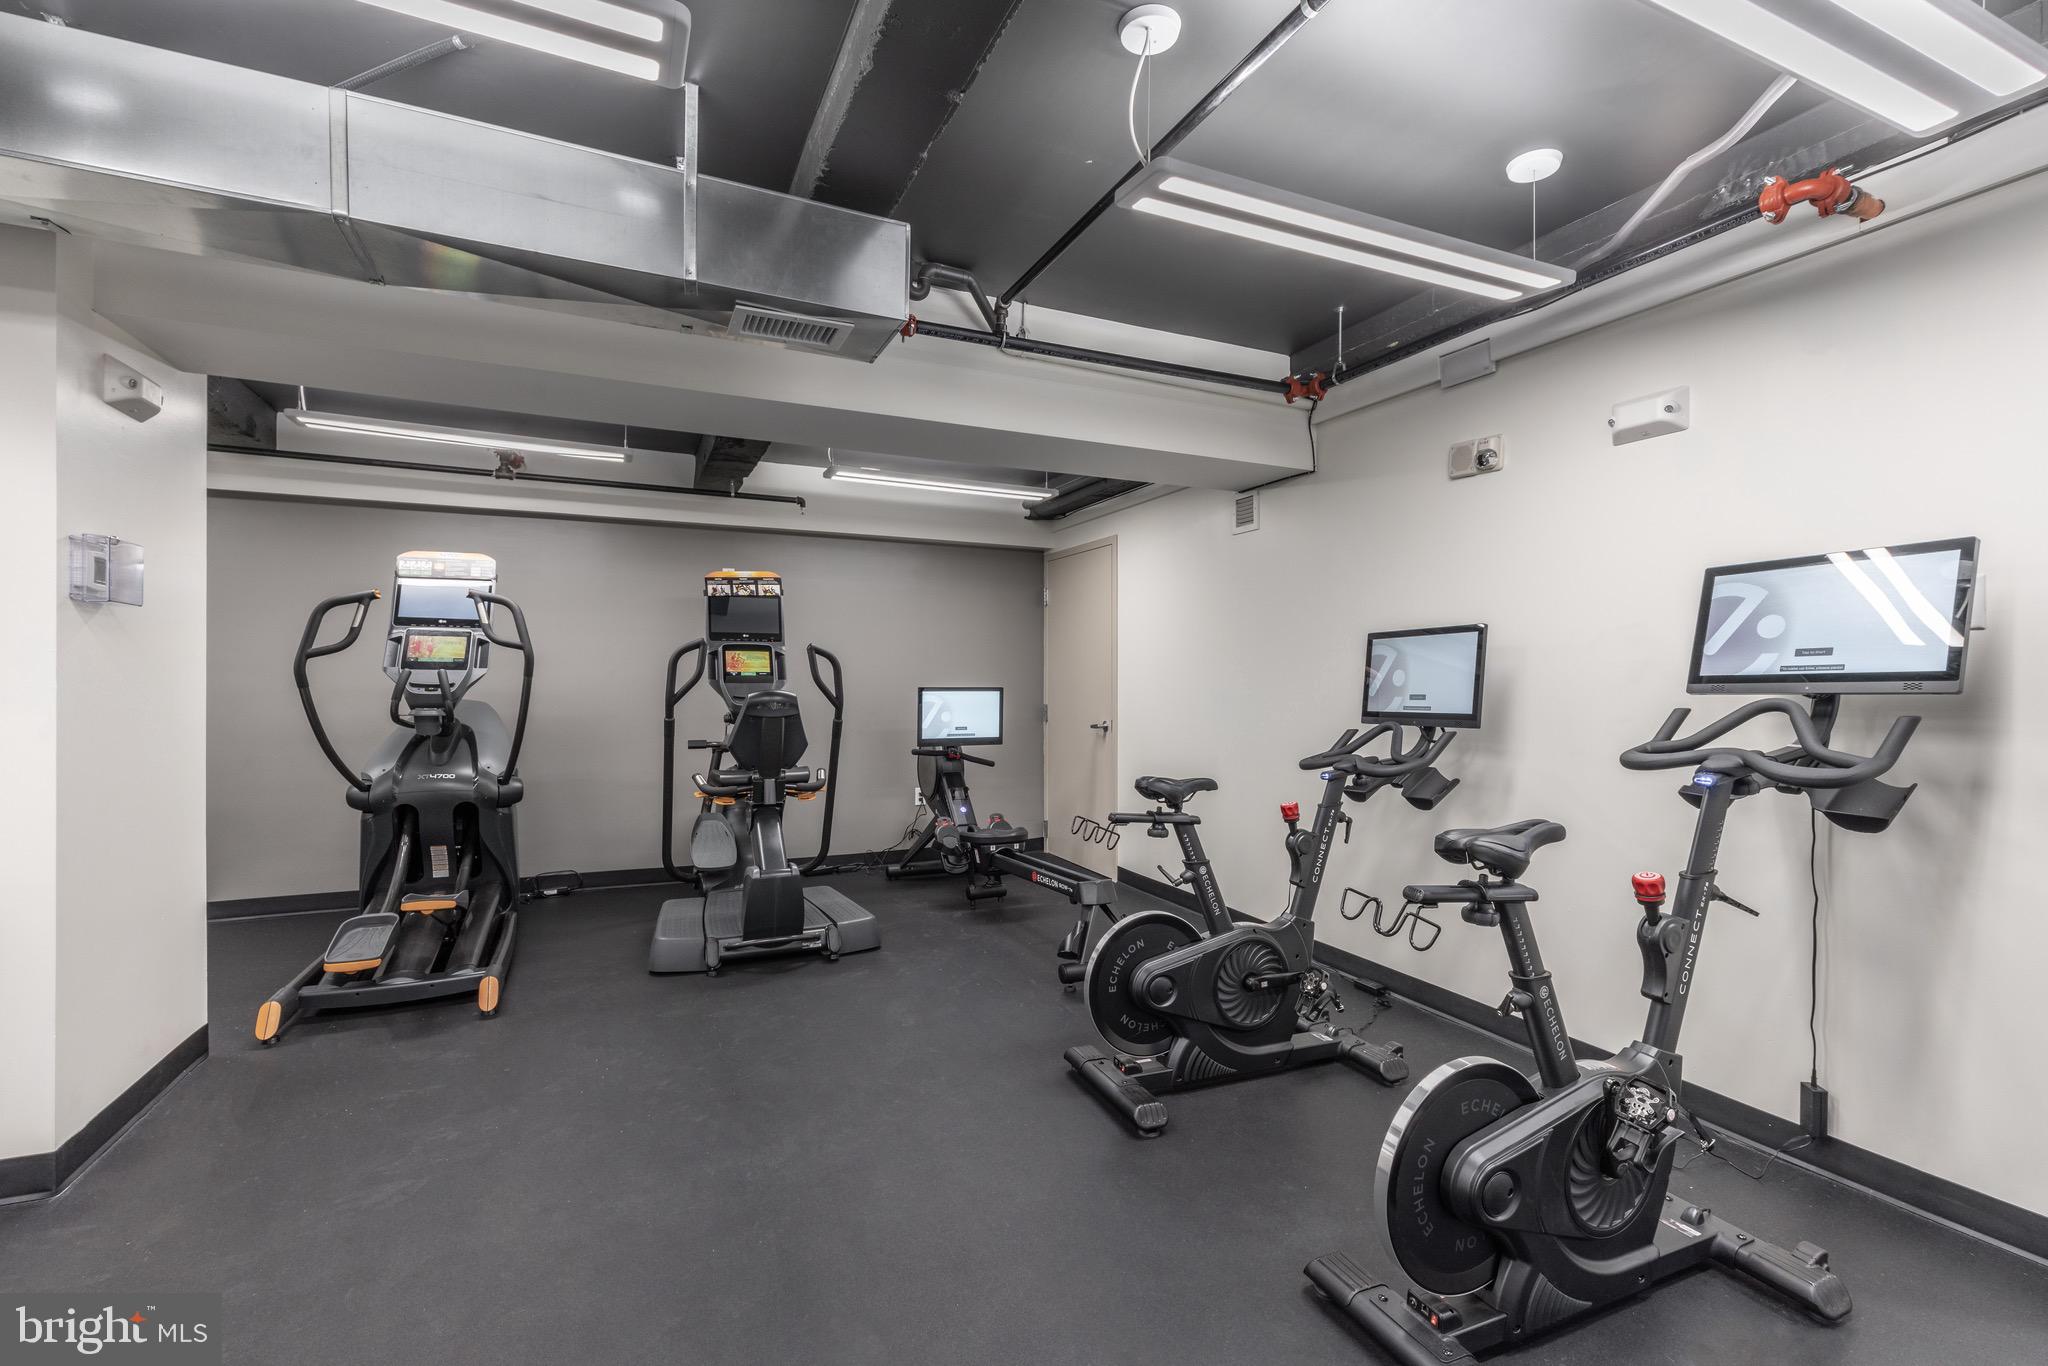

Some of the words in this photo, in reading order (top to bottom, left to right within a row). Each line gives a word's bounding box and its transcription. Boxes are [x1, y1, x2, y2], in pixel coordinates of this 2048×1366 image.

[1037, 874, 1059, 888] ECHELON
[1312, 826, 1330, 883] CONNECT
[1202, 874, 1222, 916] ECHELON
[1108, 938, 1145, 993] ECHELON
[1679, 909, 1702, 995] CONNECT
[1120, 1014, 1160, 1035] HELON
[1543, 998, 1567, 1061] ECHELON
[1413, 1137, 1437, 1237] ECHELON
